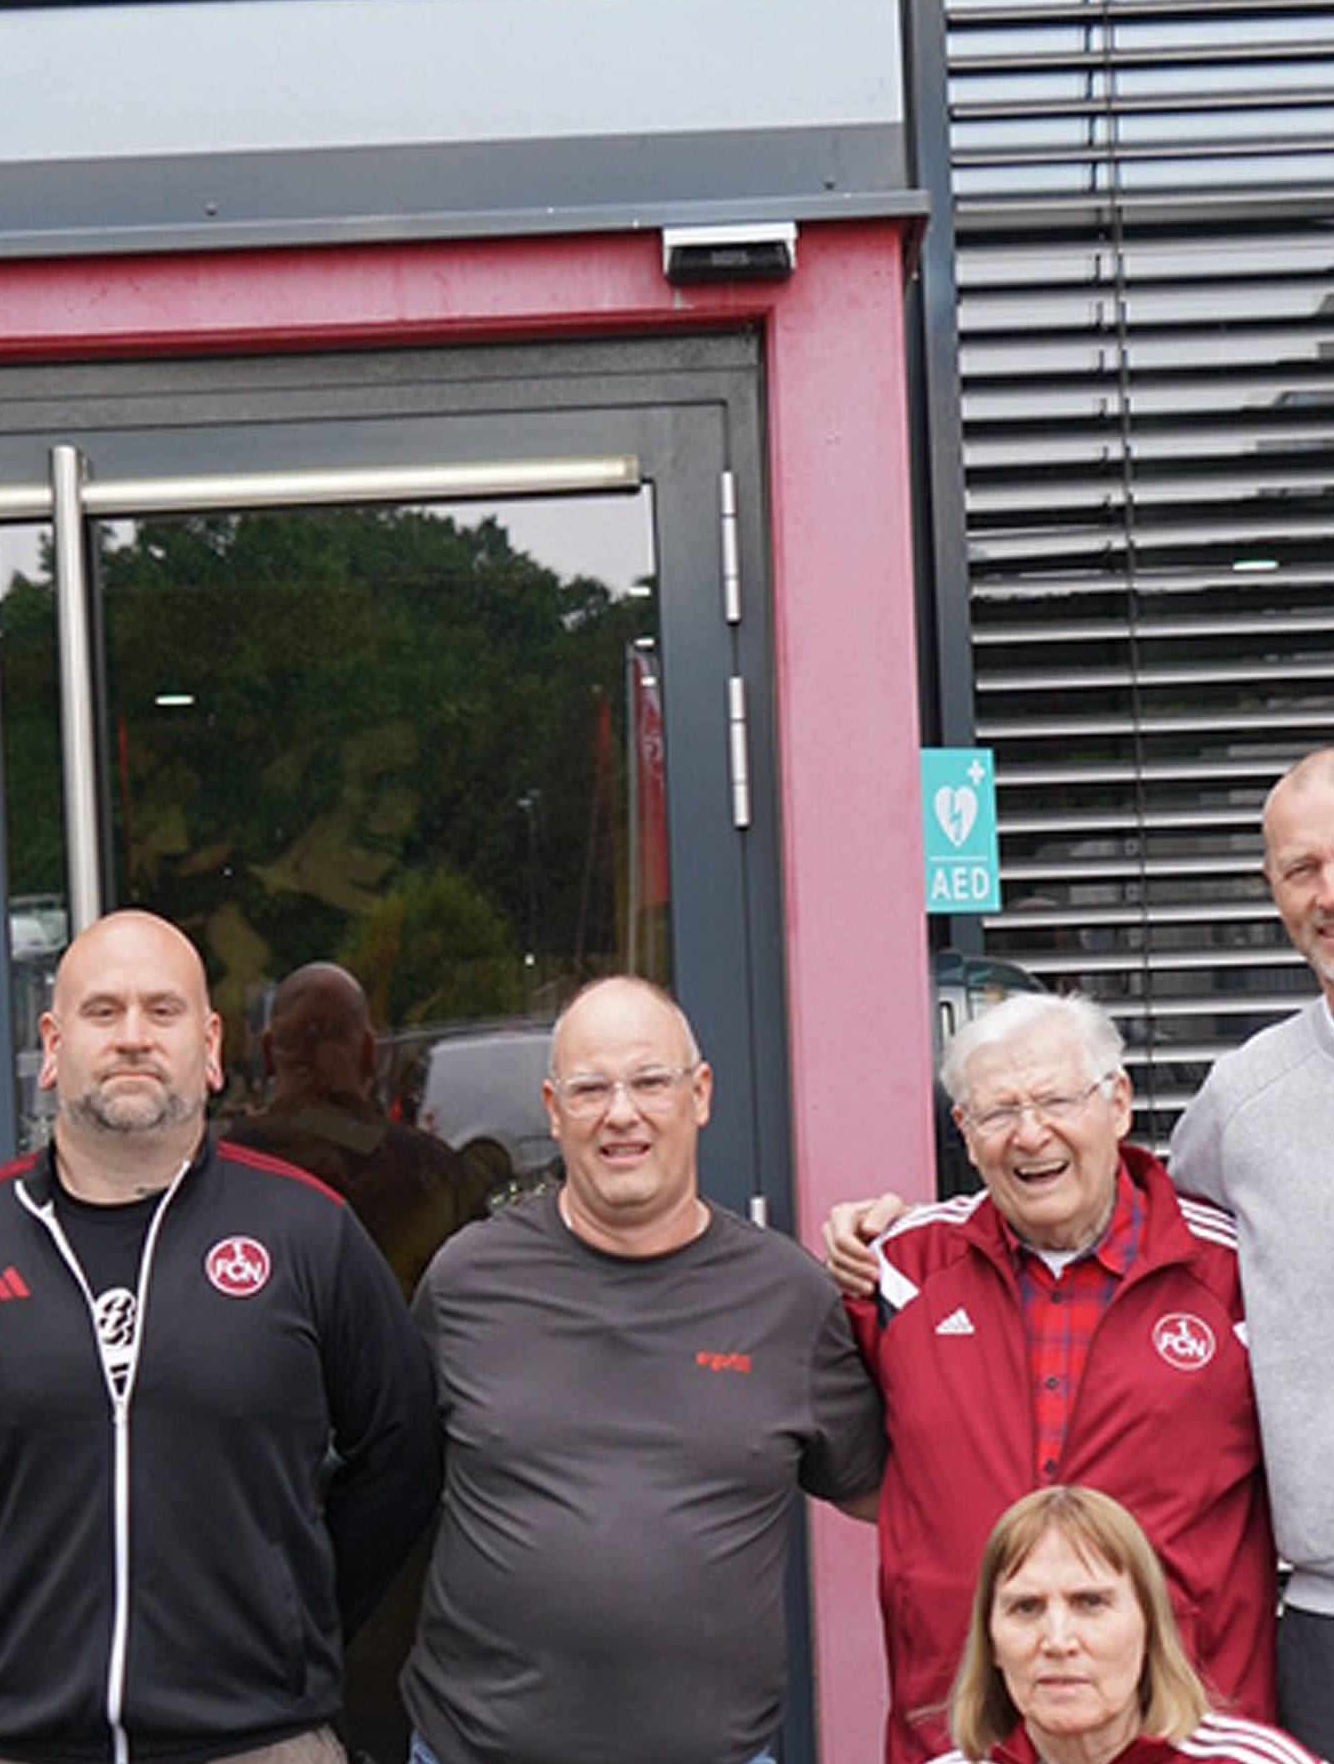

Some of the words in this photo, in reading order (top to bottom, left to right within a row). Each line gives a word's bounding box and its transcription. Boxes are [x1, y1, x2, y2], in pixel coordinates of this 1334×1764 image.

[931, 866, 989, 901] AED
[215, 1257, 263, 1283] FCN
[1157, 1331, 1206, 1358] FCN
